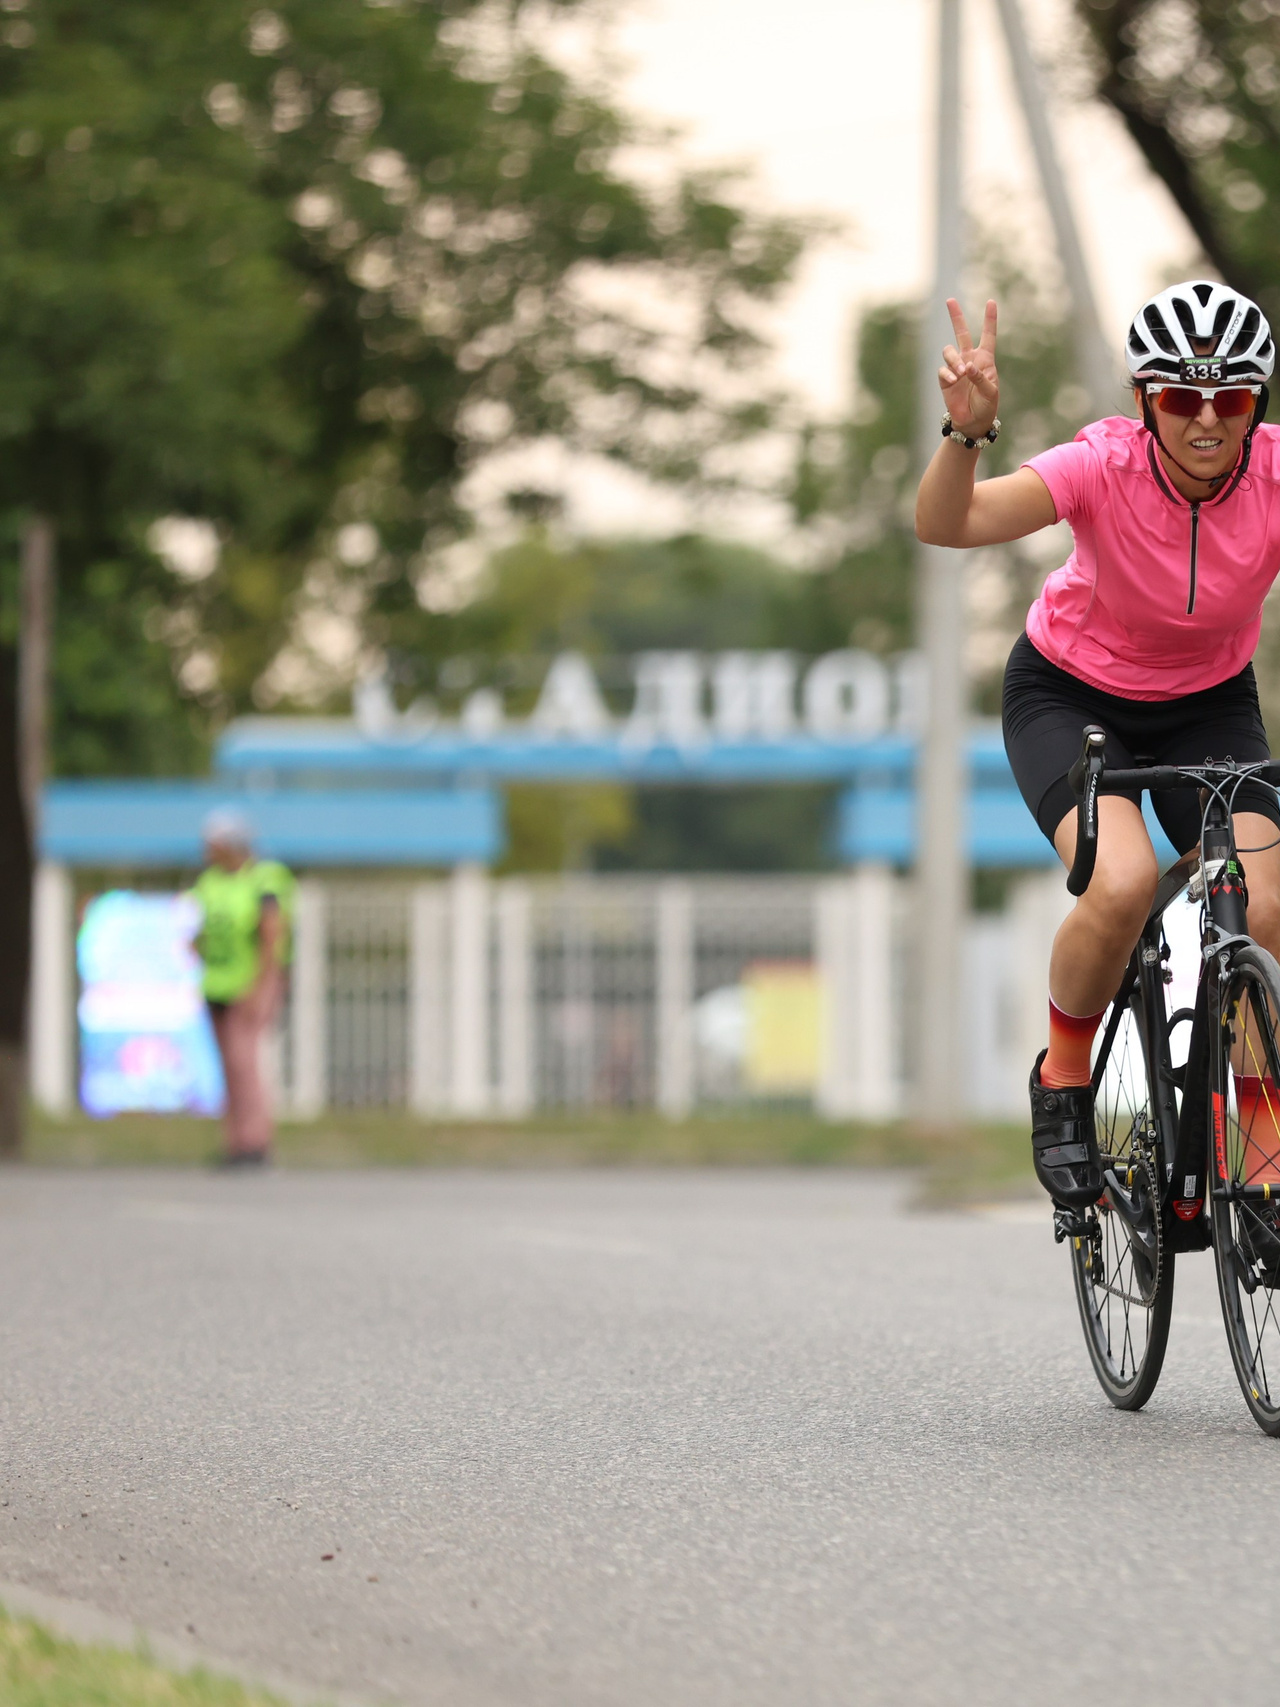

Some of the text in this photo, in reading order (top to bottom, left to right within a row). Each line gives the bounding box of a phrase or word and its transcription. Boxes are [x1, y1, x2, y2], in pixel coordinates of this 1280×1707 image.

[1185, 364, 1222, 380] 335
[352, 648, 931, 766] САДИО
[1089, 773, 1098, 822] ULTEGRA
